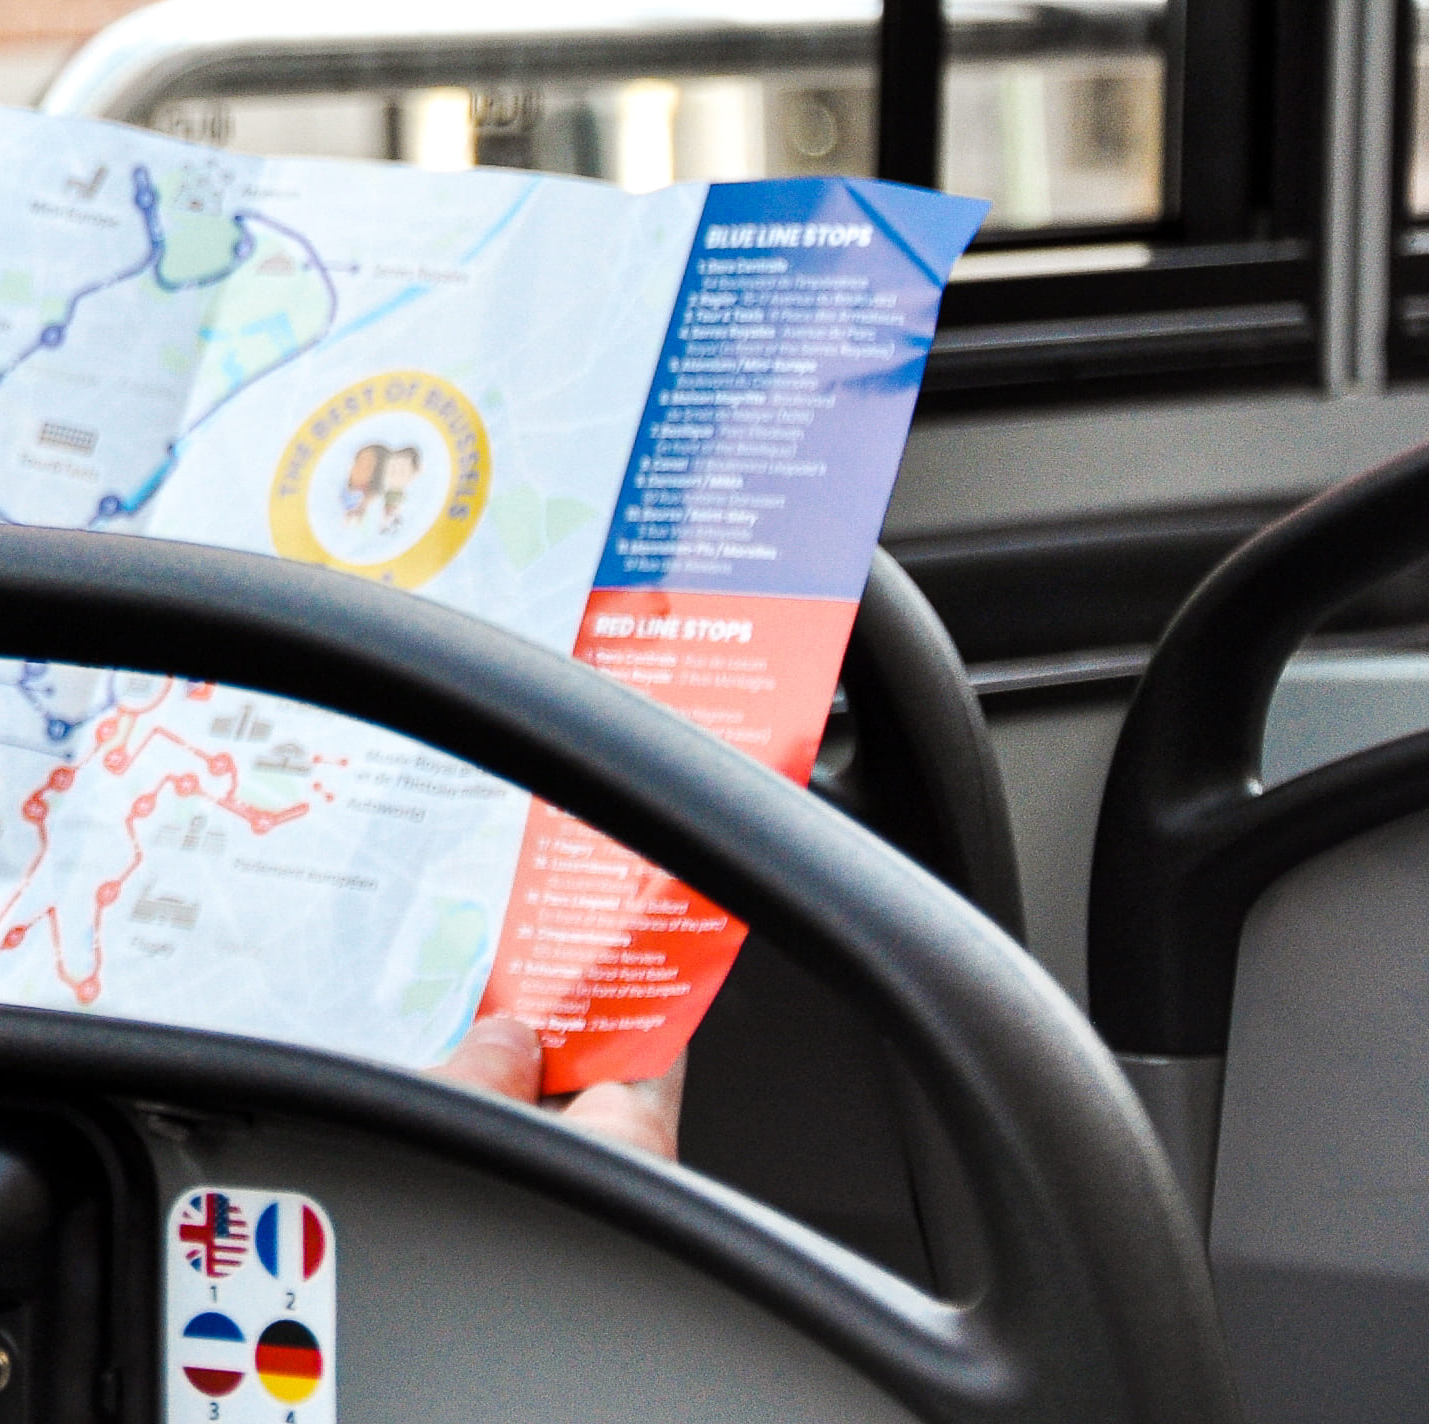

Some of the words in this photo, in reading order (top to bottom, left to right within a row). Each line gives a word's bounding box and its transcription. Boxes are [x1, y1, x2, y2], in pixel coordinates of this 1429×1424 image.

[705, 225, 753, 249] BLUE
[756, 225, 801, 248] LINE
[802, 224, 873, 248] STOPS
[310, 385, 376, 442] BEST
[384, 382, 419, 404] OF
[594, 616, 634, 638] RED
[636, 618, 681, 640] LINE
[683, 619, 753, 643] STOPS
[210, 1285, 218, 1304] 1
[286, 1292, 296, 1310] 2
[209, 1402, 220, 1421] 3
[286, 1410, 297, 1424] 4
